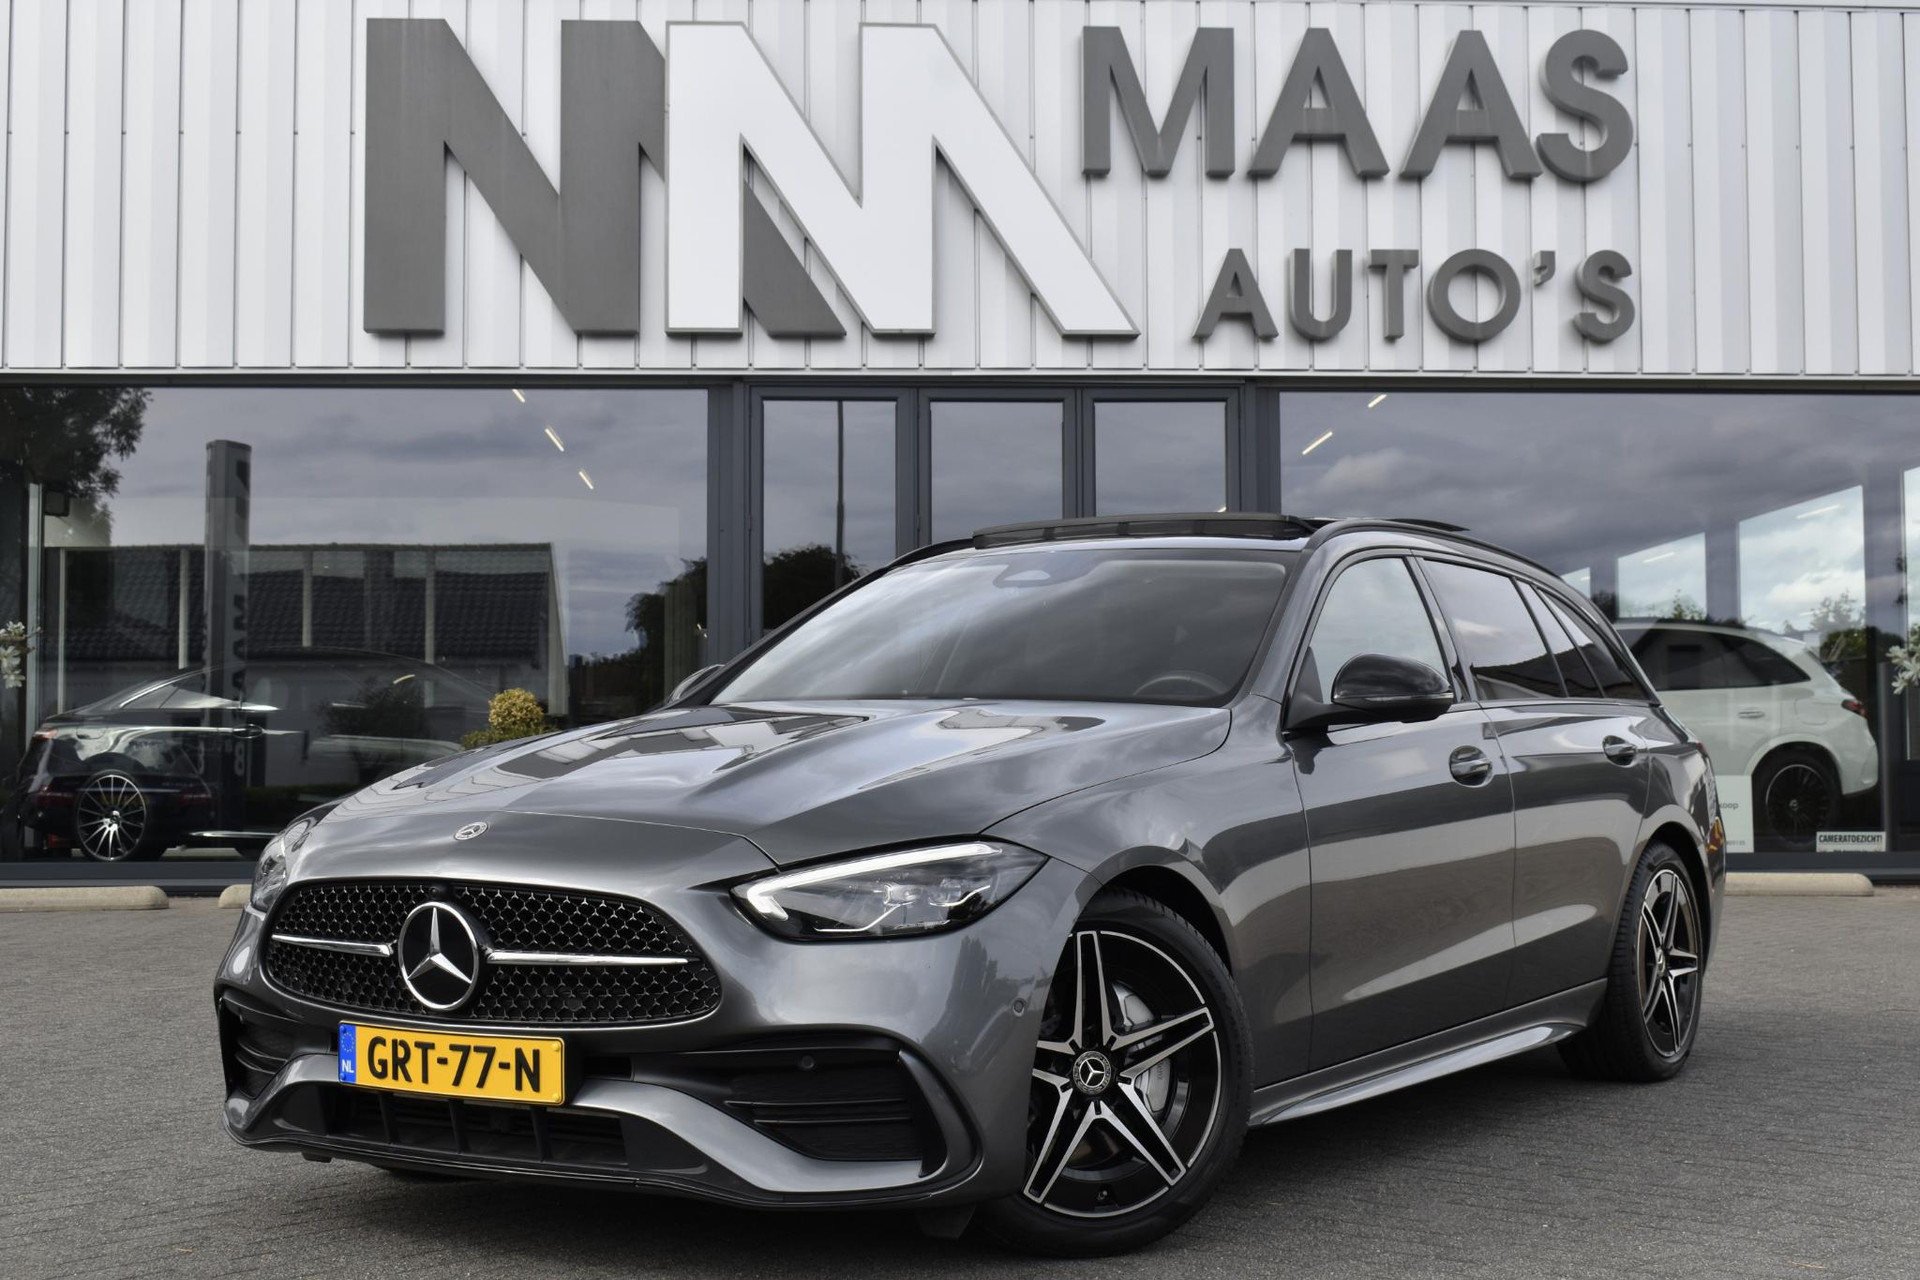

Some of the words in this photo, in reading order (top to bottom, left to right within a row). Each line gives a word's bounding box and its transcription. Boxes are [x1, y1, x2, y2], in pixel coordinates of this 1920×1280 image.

[1082, 26, 1634, 184] MAAS
[1192, 247, 1636, 344] AUTO'S
[341, 1059, 355, 1074] NL
[367, 1035, 541, 1093] GRT-77-N
